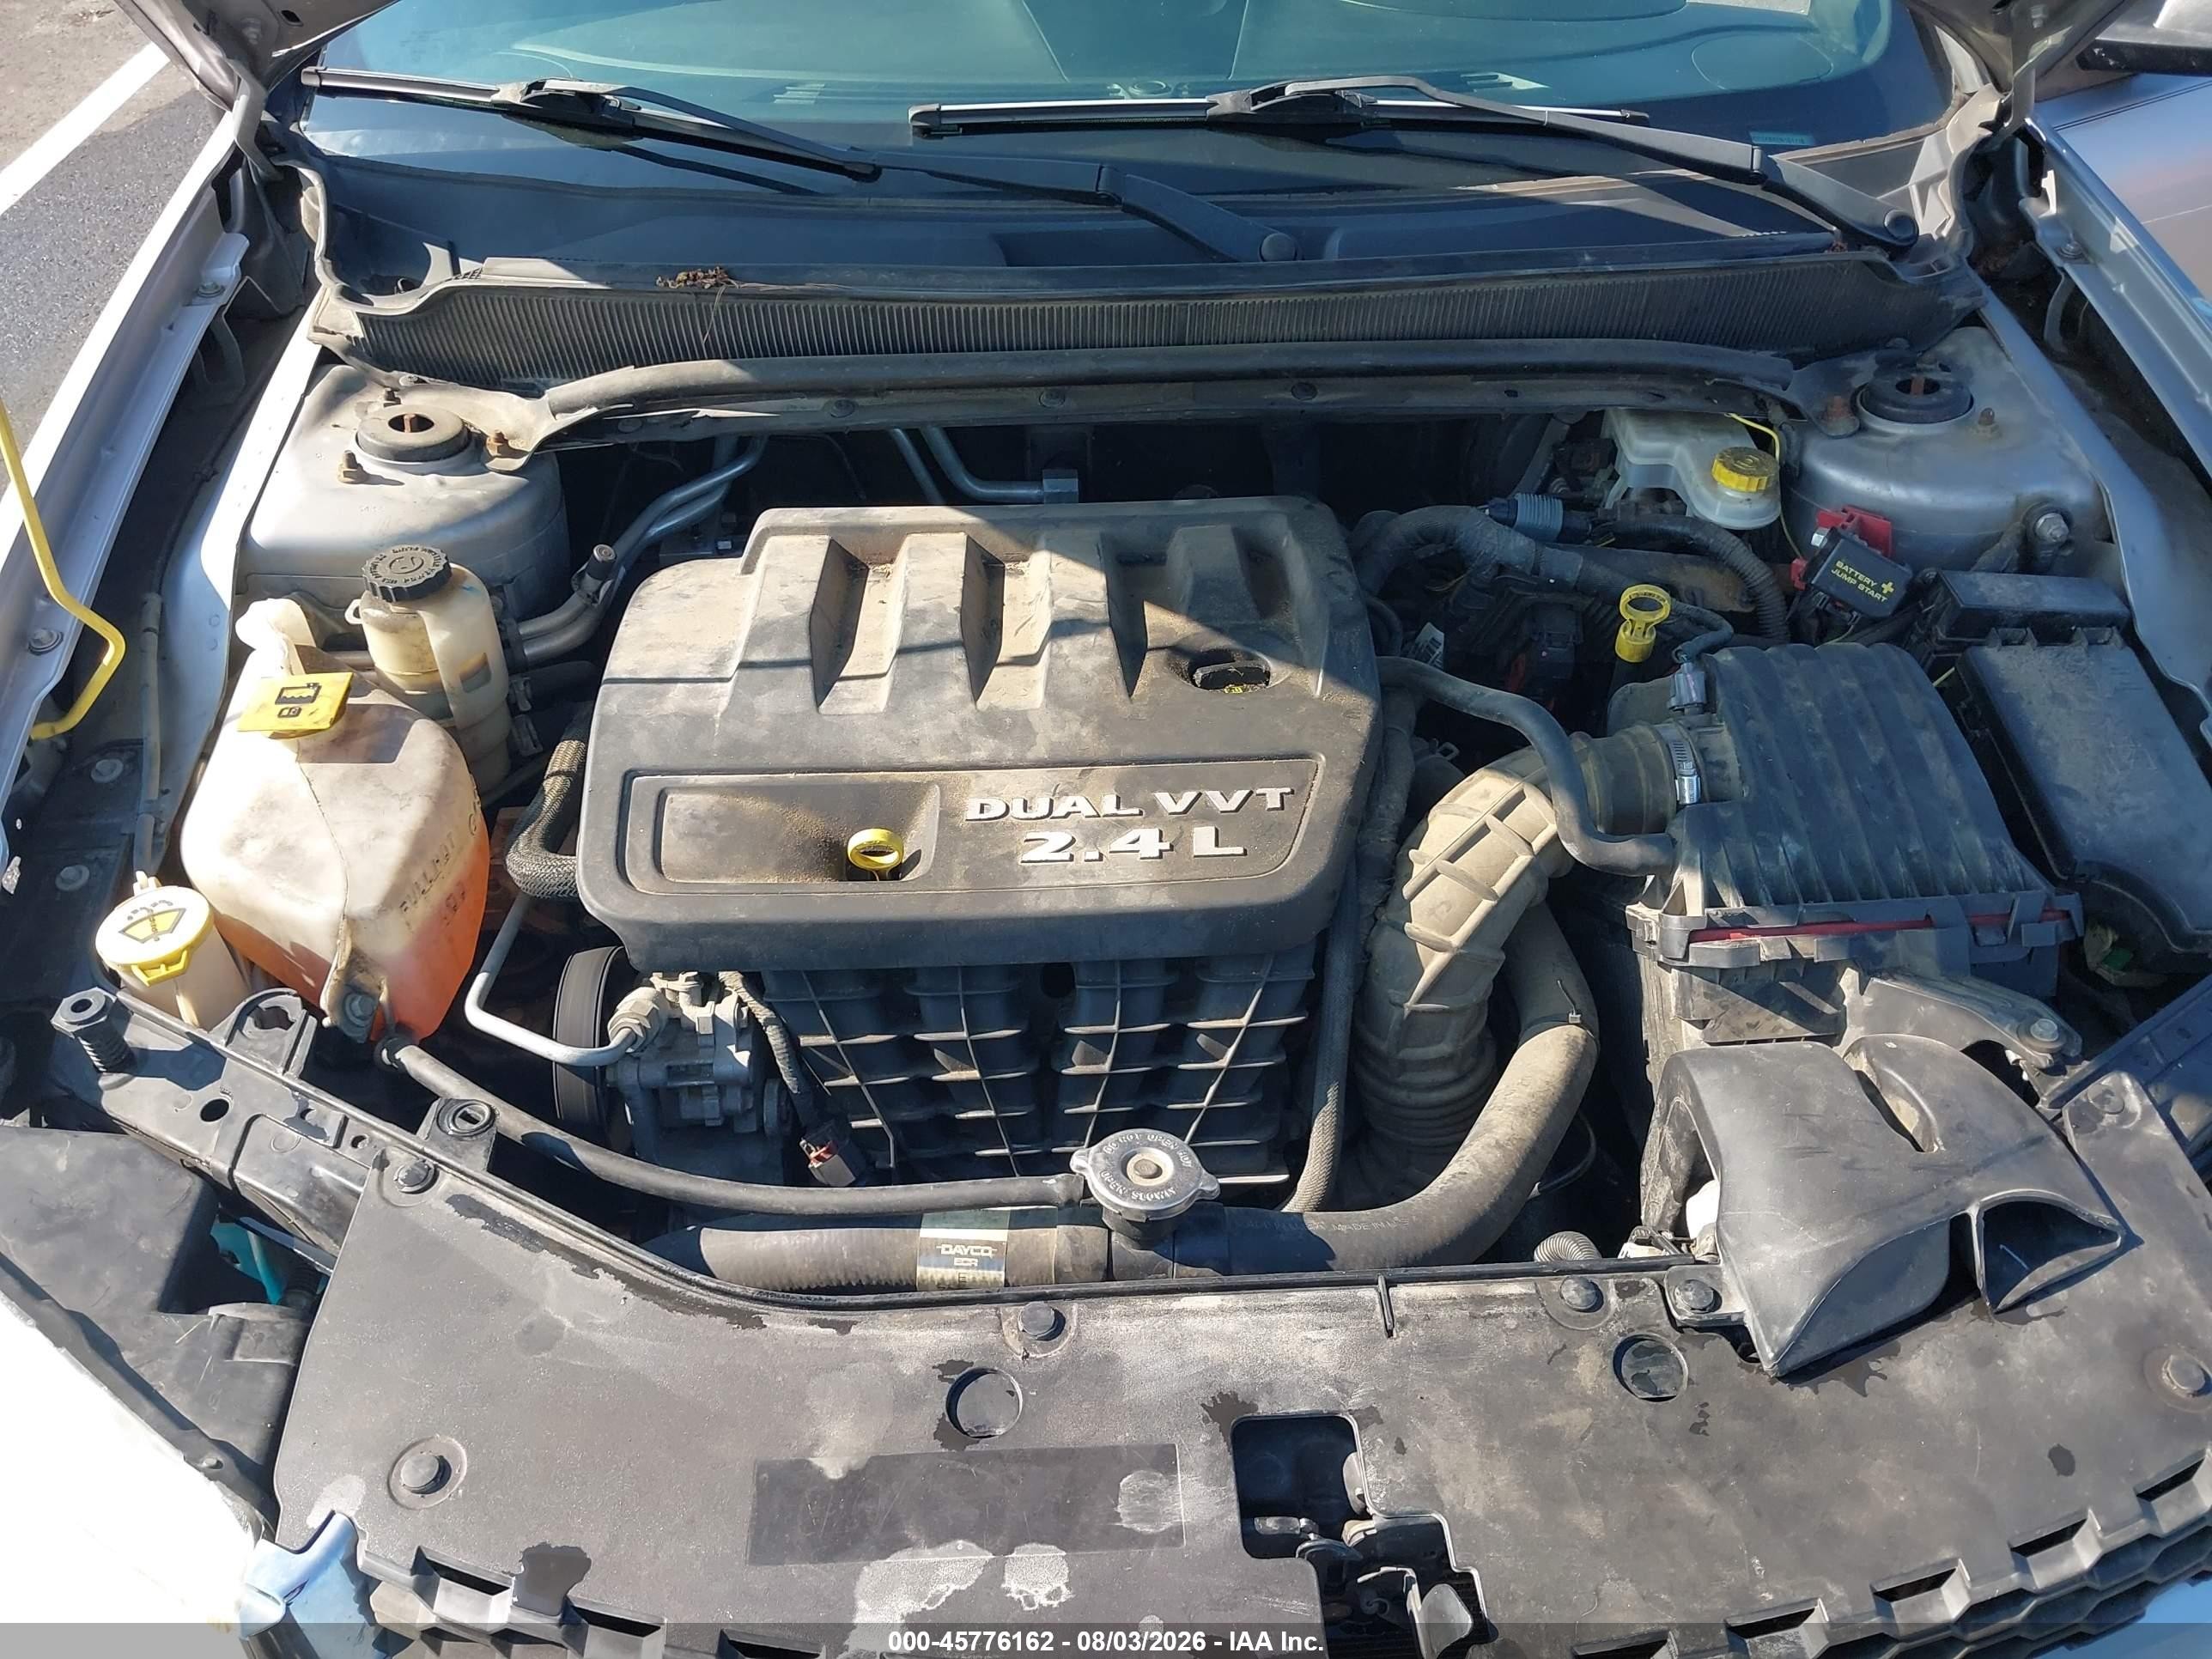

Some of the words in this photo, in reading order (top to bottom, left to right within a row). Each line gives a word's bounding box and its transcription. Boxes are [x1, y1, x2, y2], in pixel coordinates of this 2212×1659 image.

[1831, 568, 1857, 586] JUMP
[1857, 583, 1888, 603] START
[1835, 560, 1878, 587] BATTERY
[965, 794, 1143, 821] DUAL
[1154, 787, 1296, 816] VVT
[1147, 1133, 1179, 1151] OPEN
[1100, 1170, 1128, 1195] OPEN
[939, 1243, 994, 1259] DAYCO
